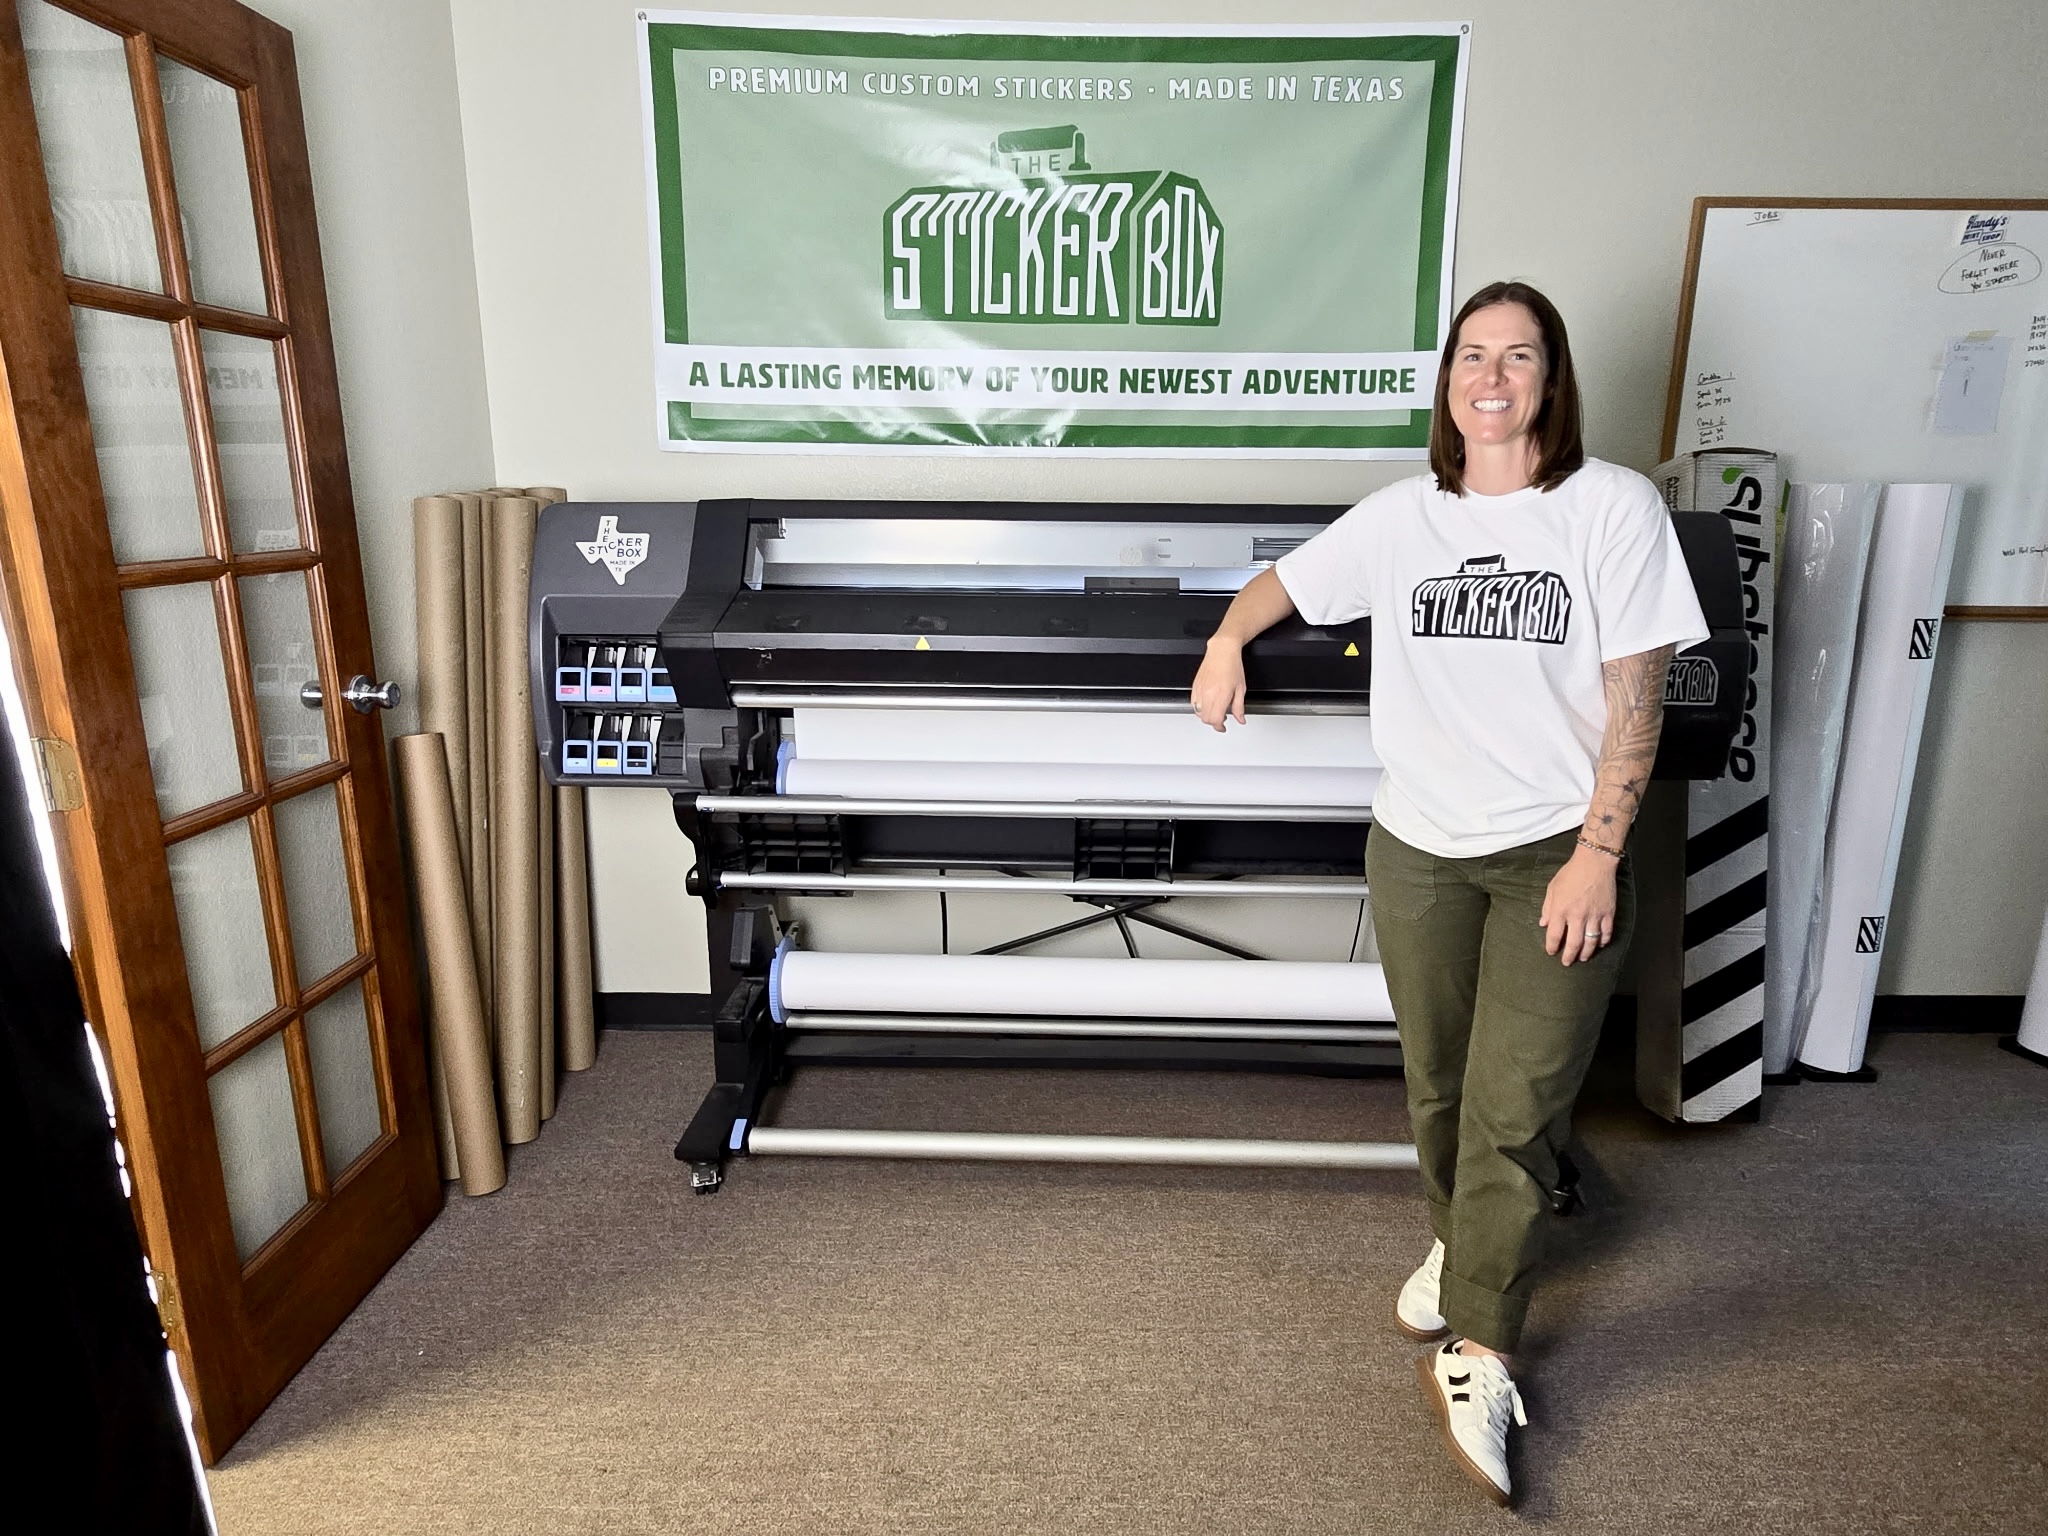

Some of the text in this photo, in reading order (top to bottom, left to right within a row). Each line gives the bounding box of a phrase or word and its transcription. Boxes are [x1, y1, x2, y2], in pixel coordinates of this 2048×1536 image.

[708, 67, 1404, 102] PREMIUM CUSTOM STICKERS MADE IN TEXAS
[1011, 153, 1061, 175] THE
[892, 182, 1219, 318] STICKER BOX
[689, 362, 1415, 394] A LASTING MEMORY OF YOUR NEWEST ADVENTURE
[602, 519, 611, 542] THE
[588, 538, 643, 554] STICKER
[617, 548, 642, 557] BOX
[1470, 565, 1494, 574] THE
[1413, 575, 1571, 642] STICKER BOX
[1689, 662, 1715, 701] BOX
